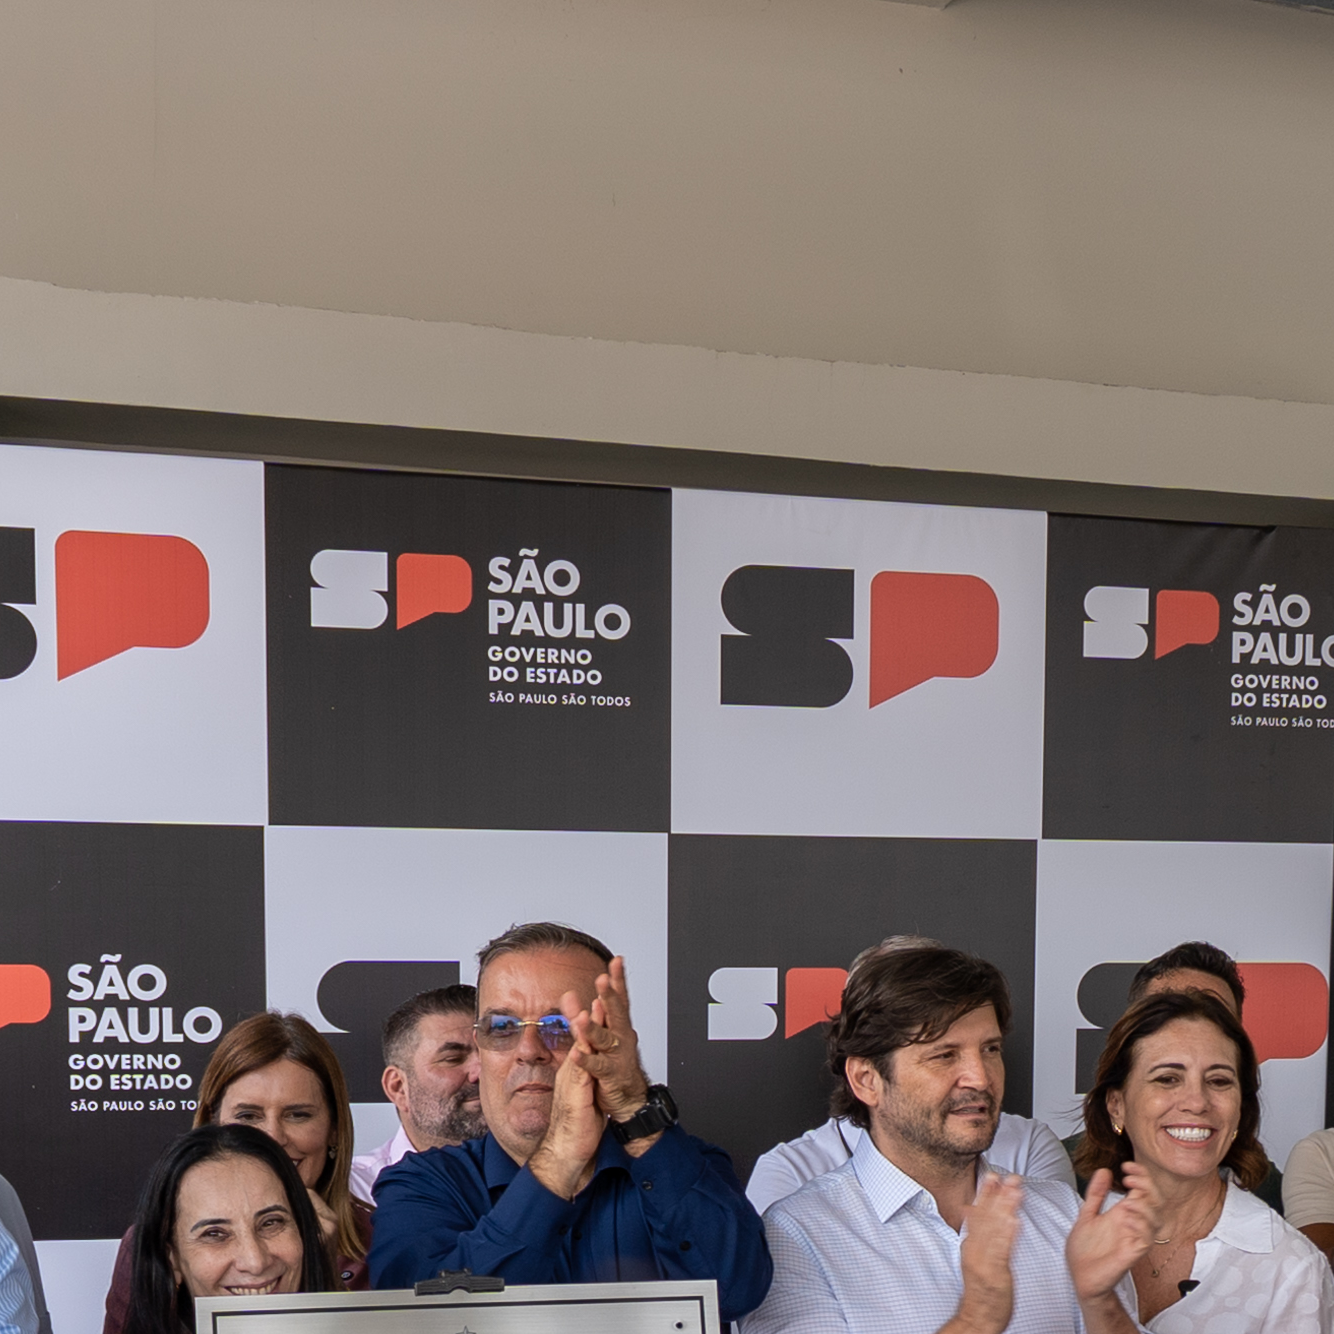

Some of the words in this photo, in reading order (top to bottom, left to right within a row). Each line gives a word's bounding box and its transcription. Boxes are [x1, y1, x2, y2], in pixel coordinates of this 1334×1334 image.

[487, 548, 580, 596] SÃO
[1231, 583, 1311, 627] SÃO
[488, 599, 631, 640] PAULO
[487, 645, 592, 665] GOVERNO
[488, 666, 519, 682] DO
[526, 667, 602, 685] ESTADO
[1230, 673, 1319, 690] GOVERNO
[489, 690, 514, 703] SÃO
[519, 693, 557, 704] PAULO
[561, 692, 586, 705] SÃO
[590, 695, 631, 707] TODOS
[1231, 692, 1257, 707] DO
[1262, 693, 1327, 709] ESTADO
[66, 953, 167, 1001] SÃO
[68, 1006, 222, 1043] PAULO
[68, 1053, 181, 1070] GOVERNO
[69, 1074, 103, 1090] DO
[109, 1073, 192, 1090] ESTADO
